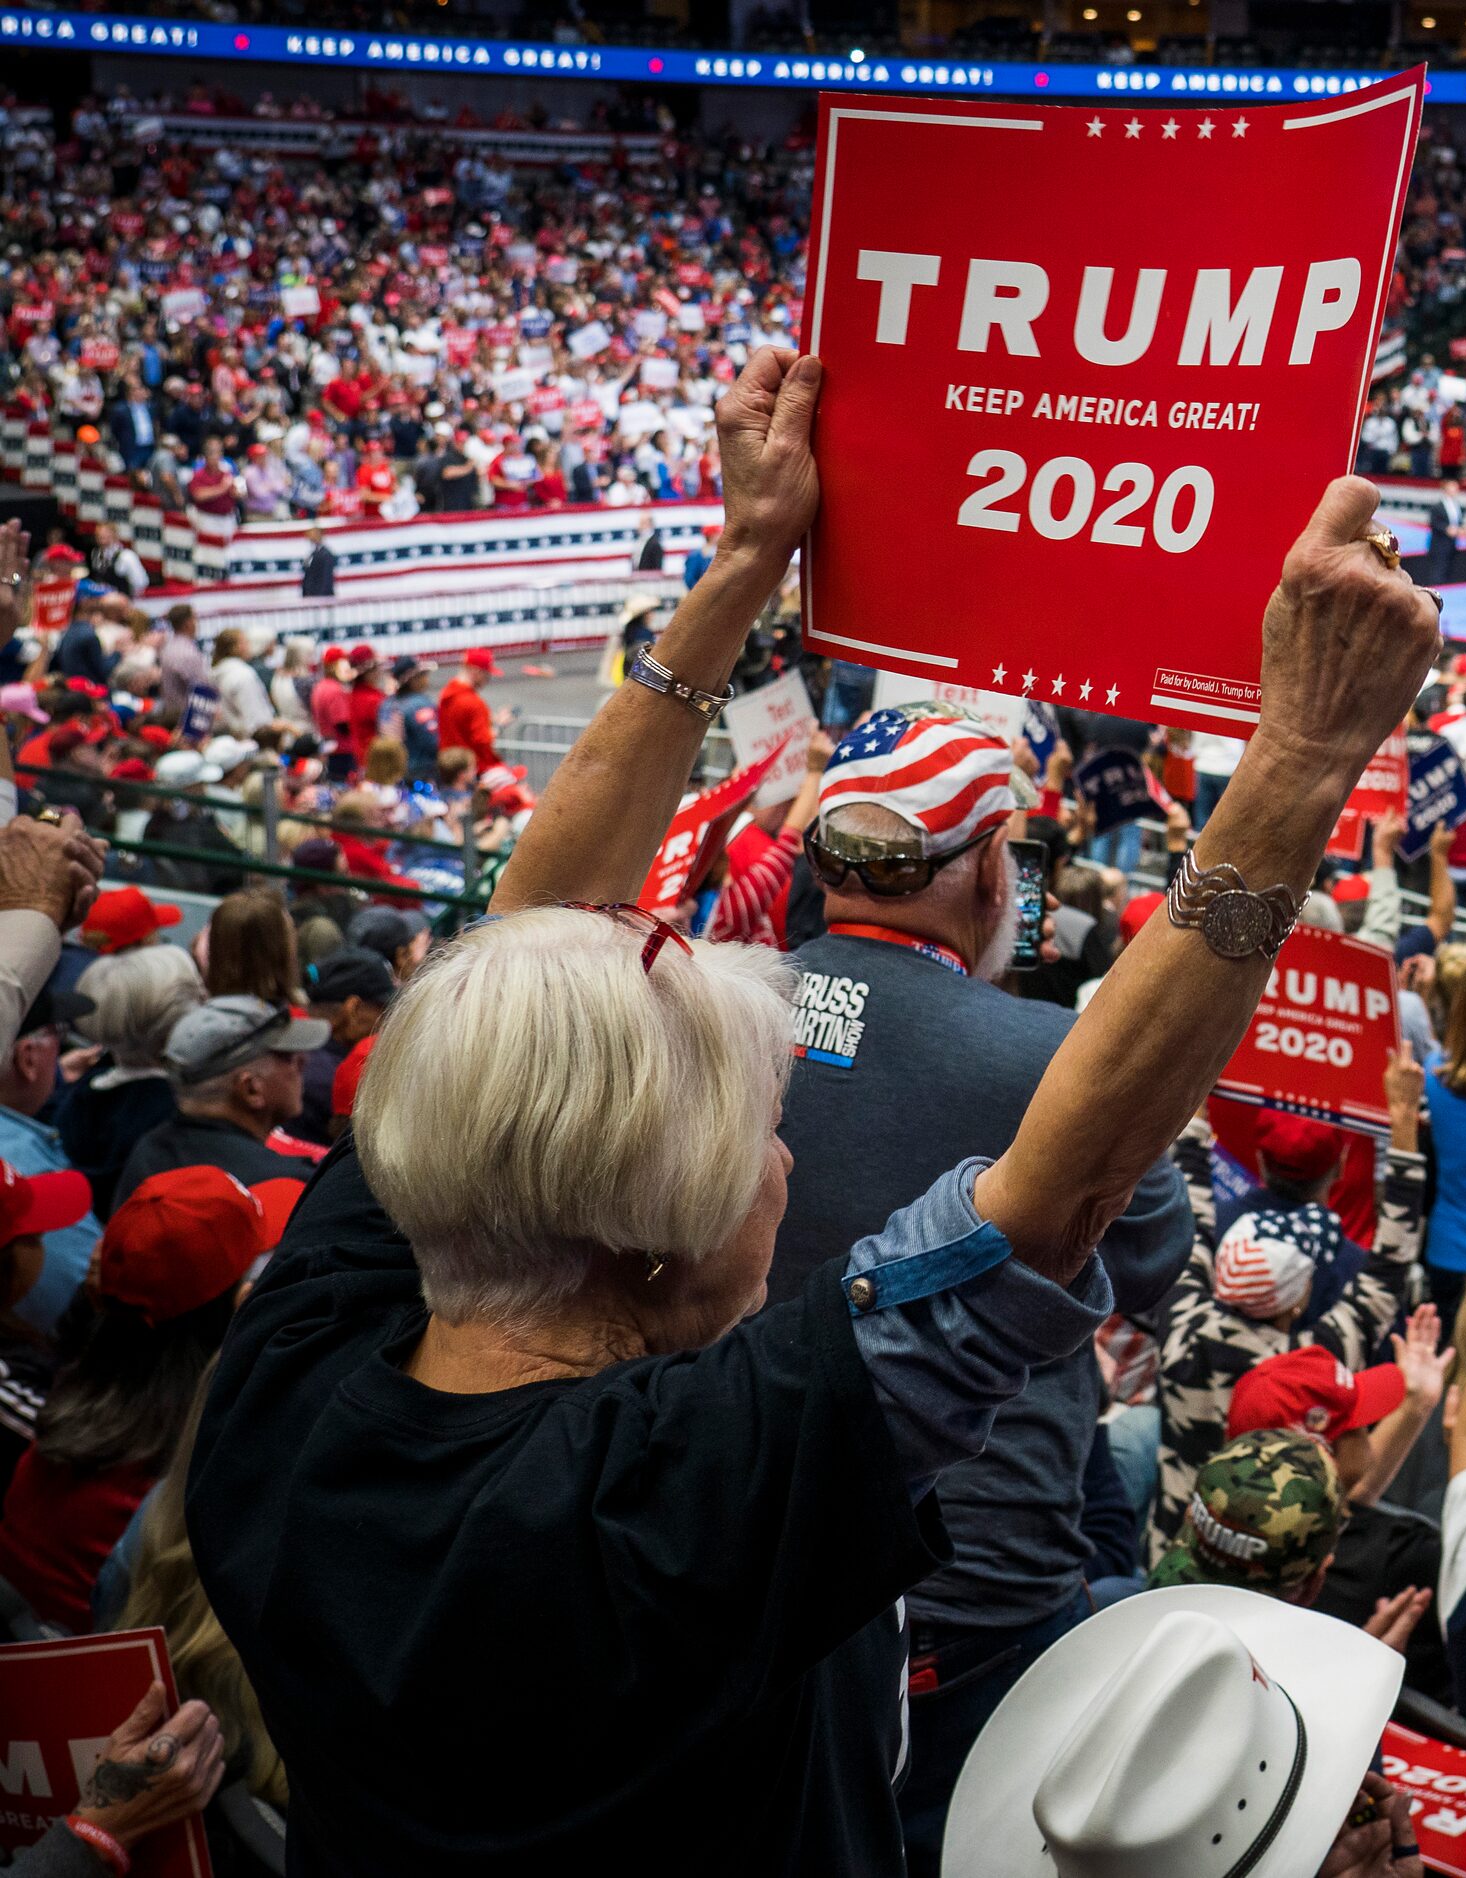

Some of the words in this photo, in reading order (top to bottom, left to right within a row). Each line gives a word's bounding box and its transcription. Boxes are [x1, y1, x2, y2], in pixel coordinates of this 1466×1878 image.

[287, 37, 355, 56] KEEP
[367, 42, 490, 64] AMERICA
[857, 250, 1361, 366] TRUMP
[945, 385, 1024, 415] KEEP
[1032, 393, 1157, 427] AMERICA
[1168, 401, 1260, 430] GREAT!
[957, 449, 1214, 553] 2020
[1160, 674, 1174, 684] Paid
[1174, 675, 1183, 687] for
[1184, 678, 1192, 690] by
[1192, 679, 1214, 692] Donald
[1222, 684, 1244, 699] Trump
[1244, 686, 1255, 699] for
[801, 973, 869, 1018] RUSS
[790, 1006, 851, 1054] ARTIN
[841, 1019, 866, 1058] SHOW
[1255, 1021, 1354, 1068] 2020
[1191, 1491, 1268, 1561] TRUMP
